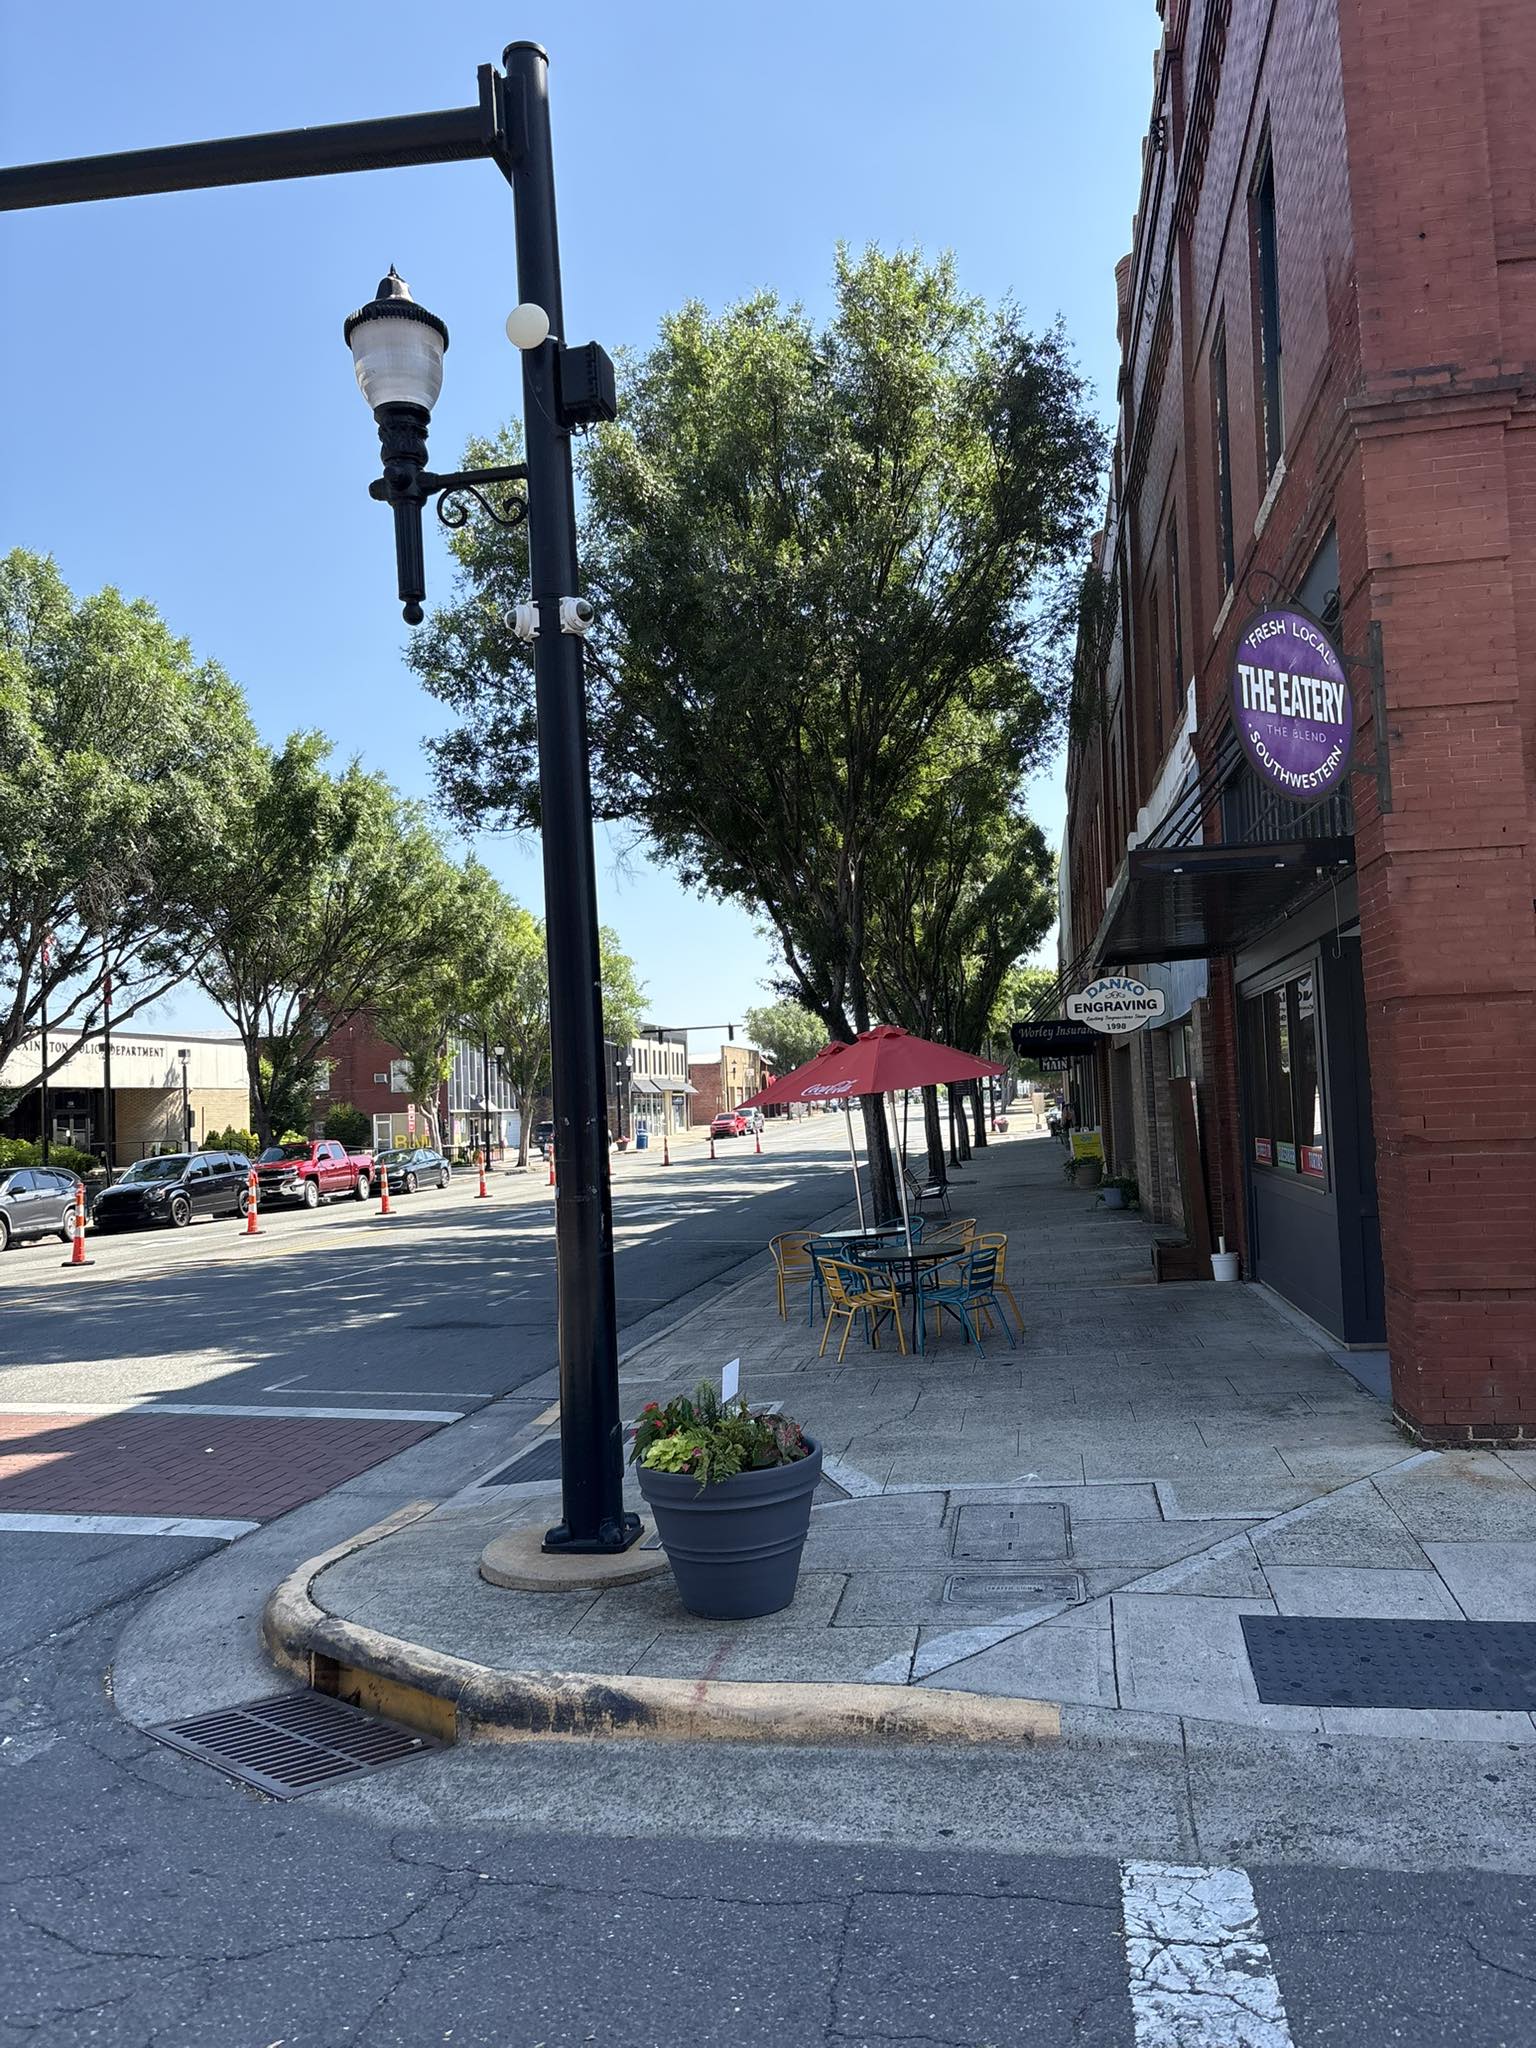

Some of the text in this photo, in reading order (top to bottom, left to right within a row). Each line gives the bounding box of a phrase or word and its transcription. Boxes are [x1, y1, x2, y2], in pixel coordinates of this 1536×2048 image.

[1249, 619, 1330, 665] FRESH LOCAL
[1238, 664, 1344, 725] THE EATERY
[1267, 724, 1327, 743] THE BLEND
[1250, 730, 1342, 789] SOUTHWESTERN
[1085, 979, 1145, 999] DANKO
[1074, 999, 1158, 1014] ENGRAVING
[1019, 1025, 1101, 1040] Worley Insuran
[1042, 1061, 1068, 1071] MAIN
